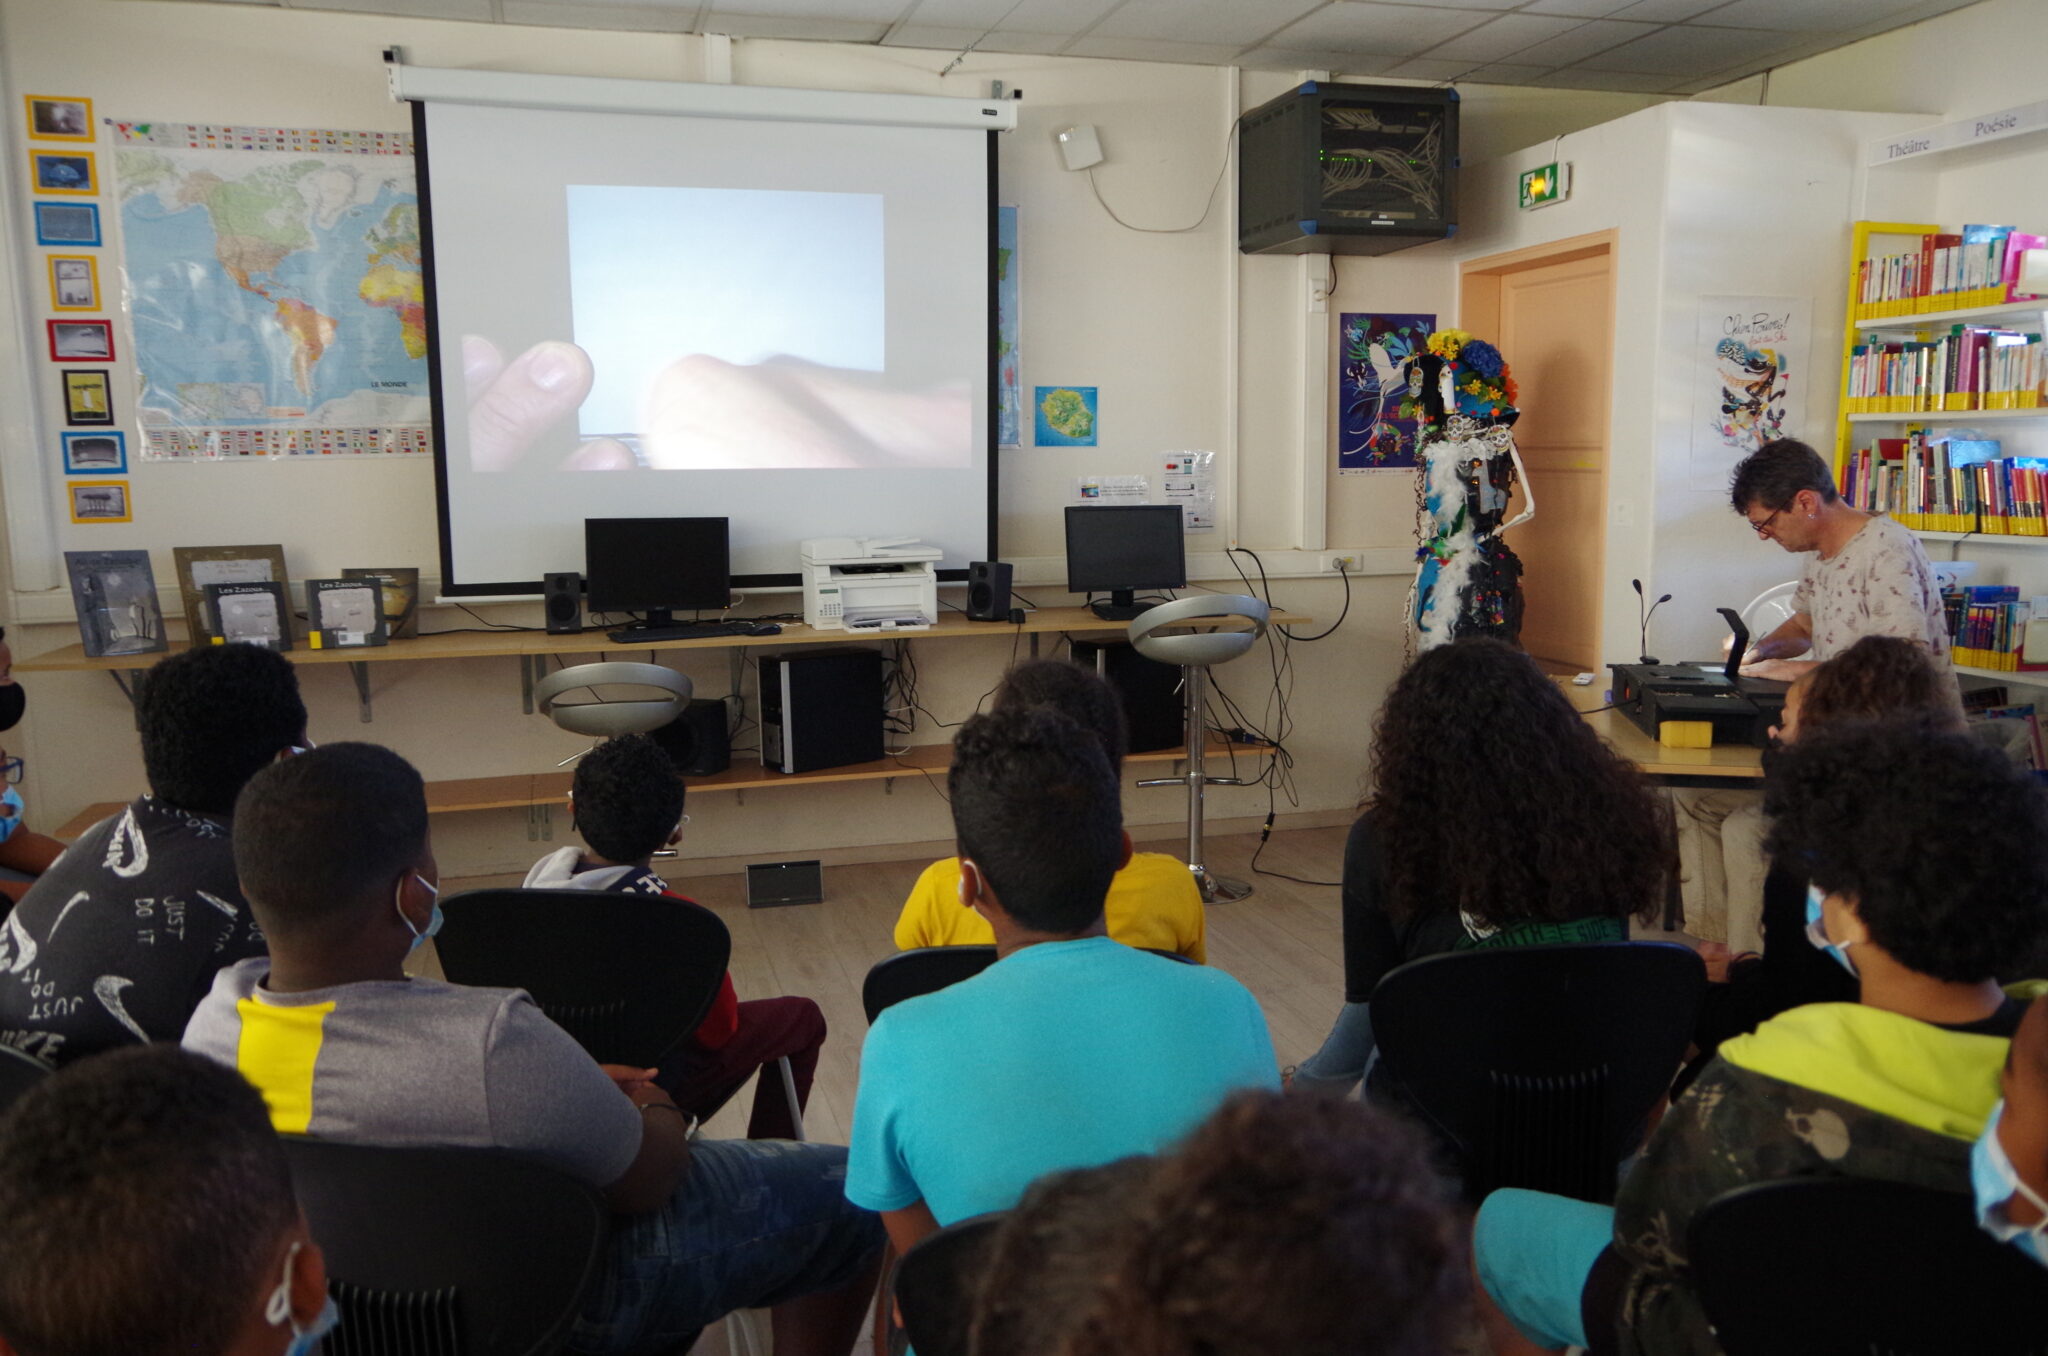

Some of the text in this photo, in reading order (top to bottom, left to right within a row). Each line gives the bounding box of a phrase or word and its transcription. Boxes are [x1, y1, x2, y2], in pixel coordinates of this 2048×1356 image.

[1975, 114, 2017, 137] Poésie
[1886, 137, 1931, 159] Théâtre
[135, 898, 155, 945] DO IT
[162, 895, 185, 941] JUST
[21, 968, 41, 983] IT
[30, 981, 55, 998] DO
[28, 996, 84, 1020] JUST
